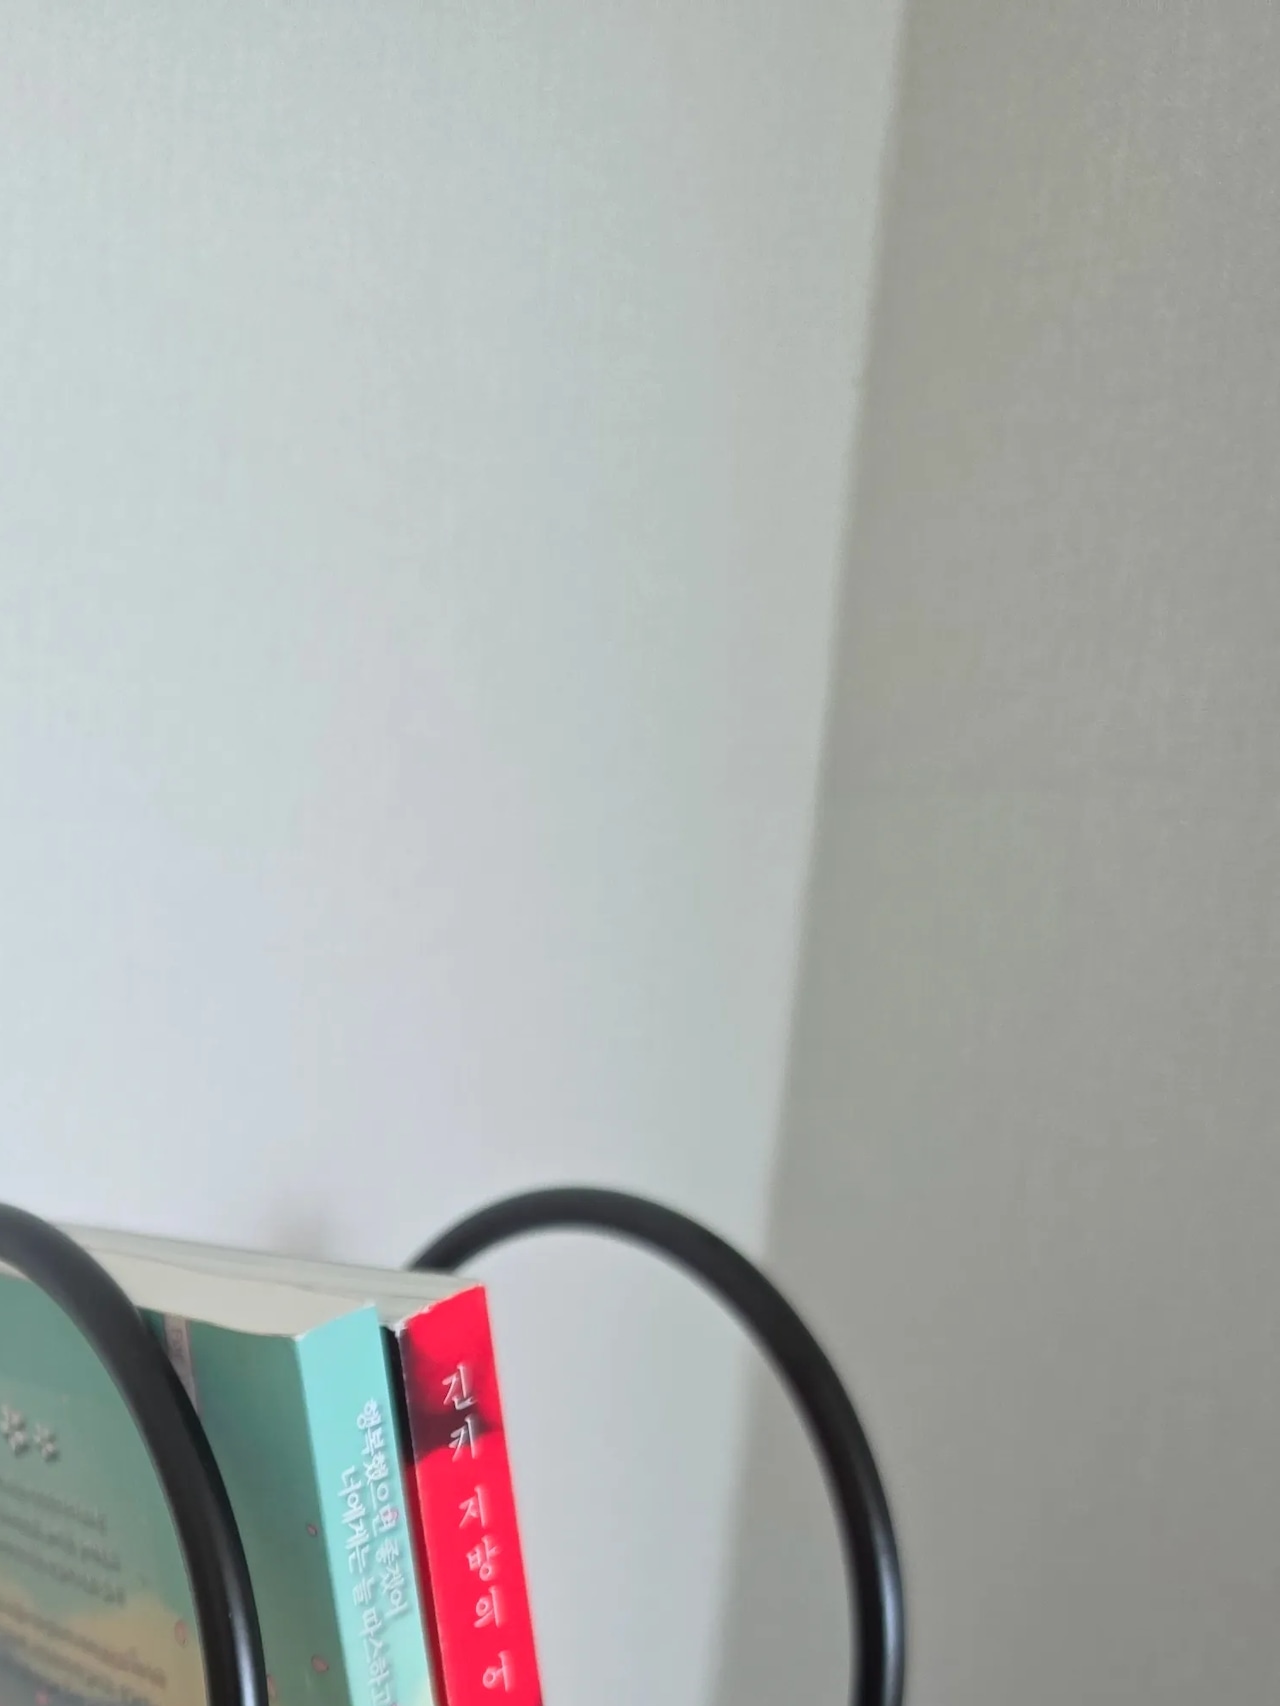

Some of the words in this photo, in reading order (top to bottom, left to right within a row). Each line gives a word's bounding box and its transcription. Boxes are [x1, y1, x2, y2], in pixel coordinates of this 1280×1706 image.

[441, 1361, 478, 1462] 긴키
[337, 1465, 369, 1574] 너에게는
[356, 1399, 398, 1537] 행복했으면
[374, 1537, 409, 1617] 좋겠어
[458, 1485, 503, 1628] 지방의
